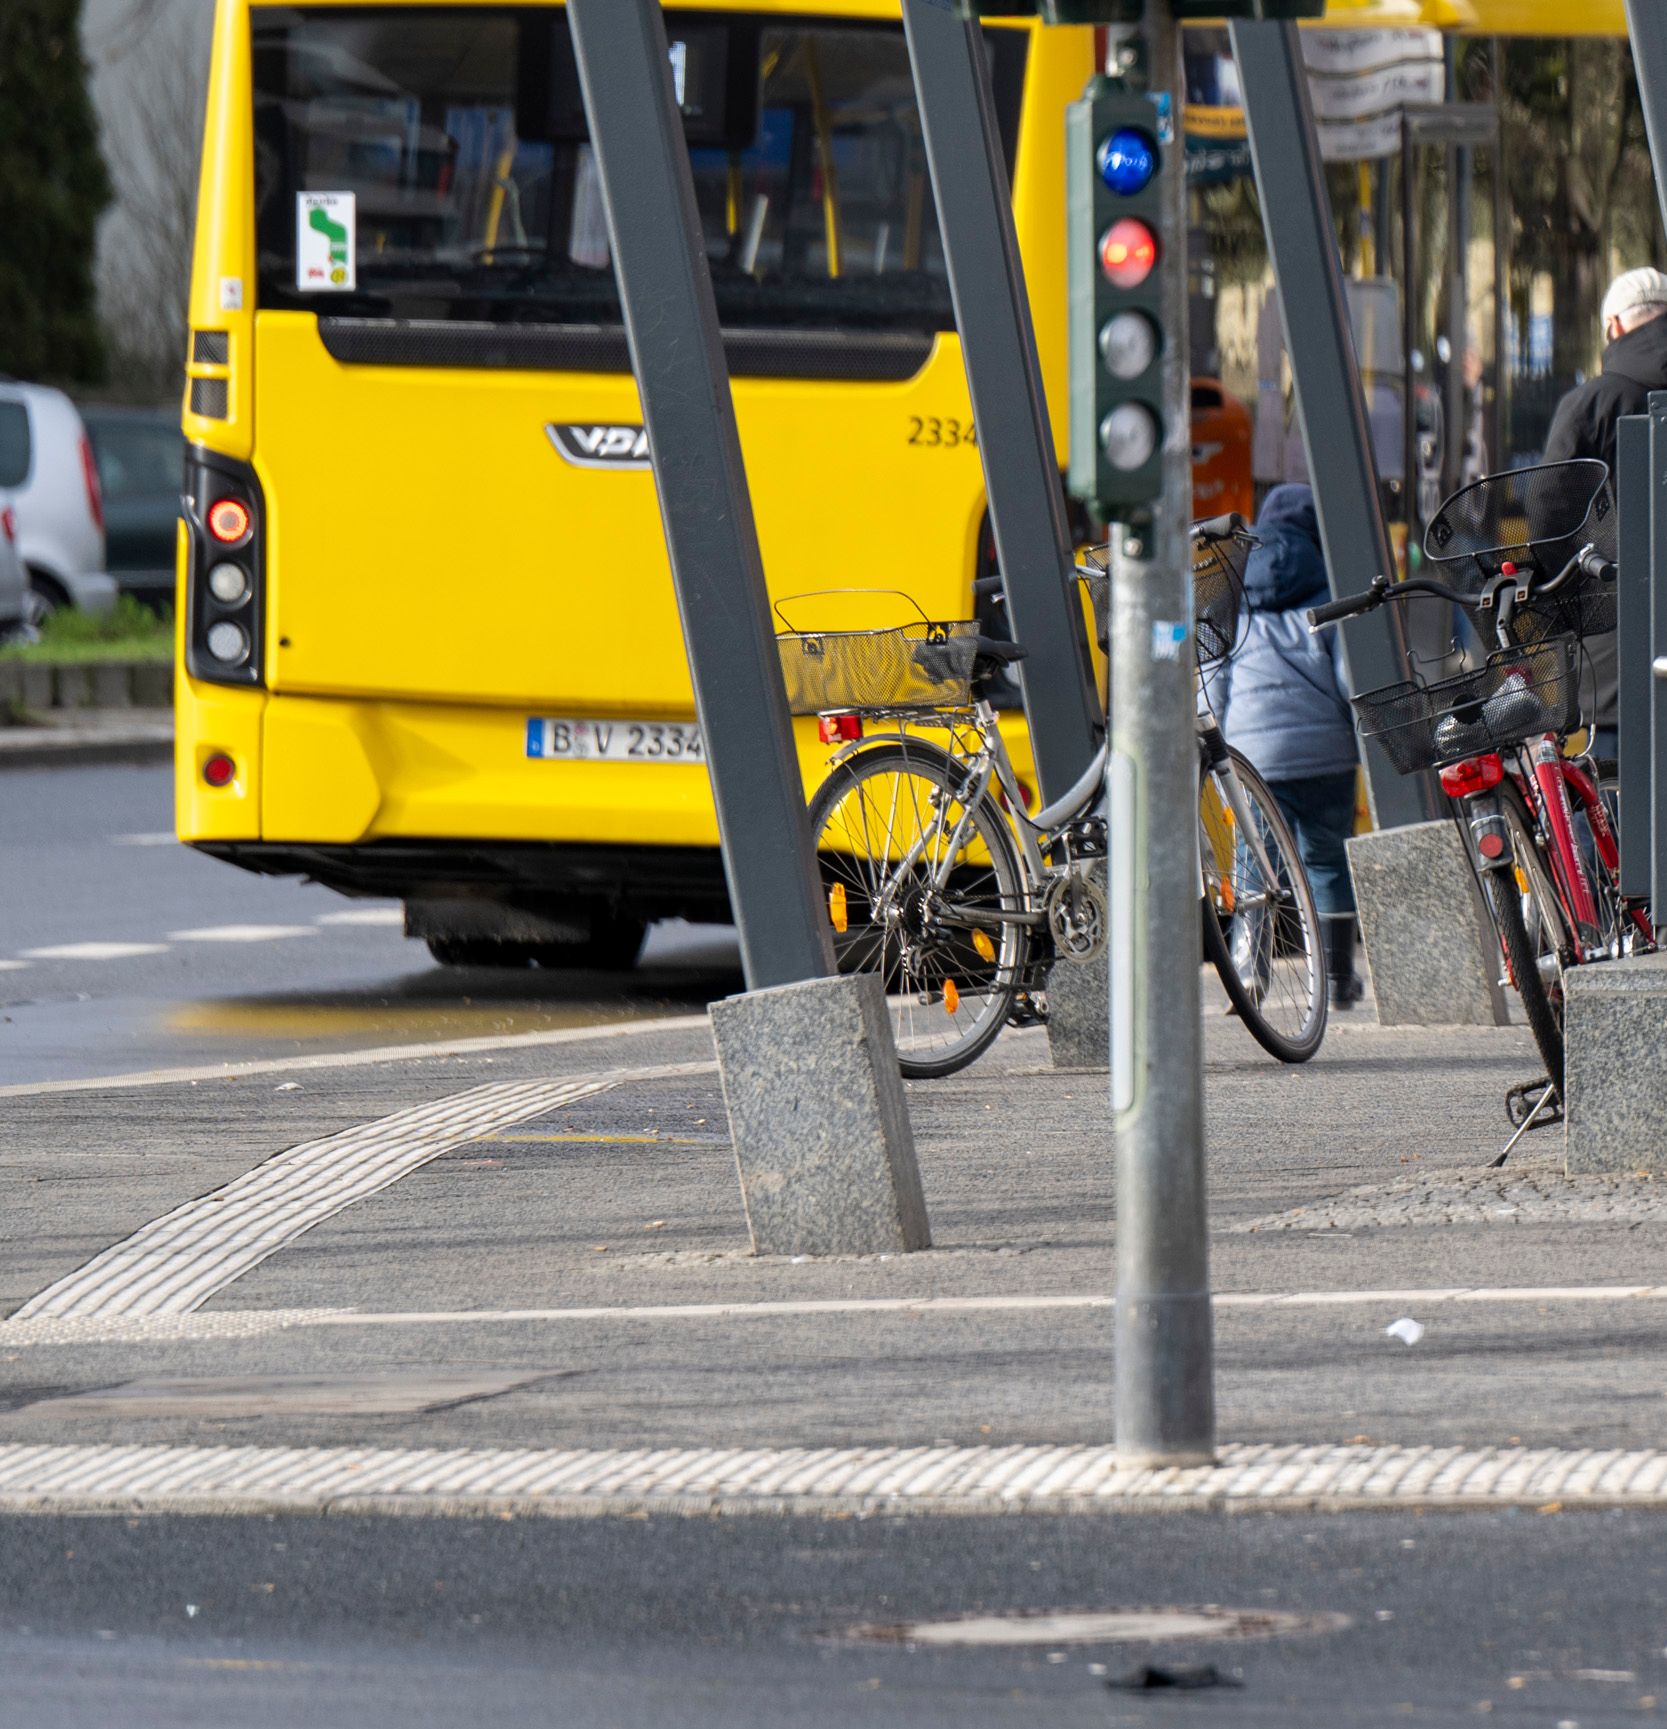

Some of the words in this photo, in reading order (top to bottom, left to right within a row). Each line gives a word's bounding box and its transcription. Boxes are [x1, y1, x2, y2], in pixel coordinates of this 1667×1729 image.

[908, 415, 978, 448] 2334
[553, 724, 571, 753] B
[593, 725, 612, 754] V
[627, 725, 701, 757] 2334
